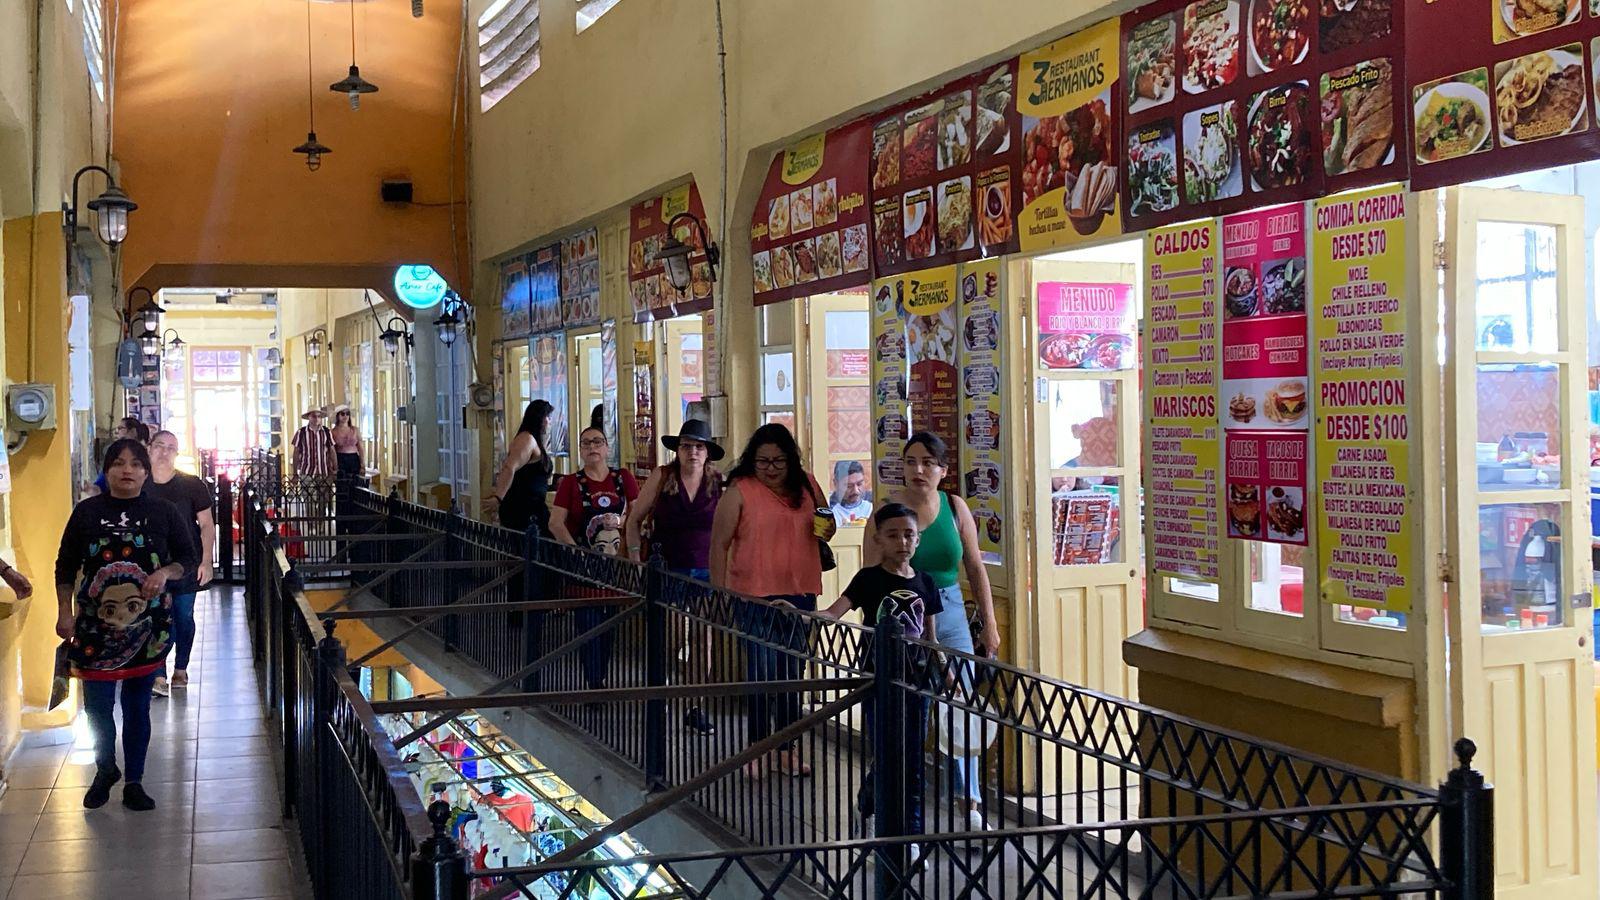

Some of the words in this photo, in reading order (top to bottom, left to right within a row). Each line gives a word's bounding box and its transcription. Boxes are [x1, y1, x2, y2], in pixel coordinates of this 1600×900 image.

[1050, 48, 1100, 78] RESTAURANT
[1028, 60, 1050, 106] 3
[1040, 62, 1104, 102] HERMANOS
[1330, 74, 1360, 90] Pescado
[1360, 68, 1378, 82] Frito
[1269, 96, 1286, 108] Birria
[1201, 112, 1219, 126] Sopes
[1317, 202, 1354, 231] COMIDA
[1358, 193, 1405, 224] CORRIDA
[1226, 220, 1260, 244] MENUDO
[1267, 212, 1299, 236] BIRRIA
[1154, 228, 1210, 256] CALDOS
[1332, 232, 1364, 260] DESDE
[1368, 229, 1386, 255] $70
[1152, 265, 1162, 280] RES
[1202, 258, 1214, 273] $80
[1348, 266, 1368, 280] MOLE
[1152, 284, 1168, 300] POLLO
[1203, 279, 1214, 296] $70
[1332, 286, 1352, 300] CHILE
[1354, 282, 1386, 298] RELLENO
[1060, 287, 1115, 312] MENUDO
[1322, 303, 1354, 318] COSTILLA
[1357, 302, 1366, 315] DE
[1368, 299, 1398, 314] PUERCO
[1152, 306, 1177, 322] PESCADO
[1202, 302, 1214, 318] $80
[1074, 316, 1102, 329] BLANCO
[1337, 318, 1382, 334] ALBONDIGAS
[1152, 326, 1179, 343] CAMARON
[1200, 323, 1214, 340] $100
[1264, 336, 1304, 350] HAMBURGUESA
[1320, 339, 1340, 352] POLLO
[1342, 338, 1351, 351] EN
[1354, 336, 1377, 350] SALSA
[1379, 334, 1404, 348] VERDE
[1152, 348, 1169, 364] MIXTO
[1200, 345, 1214, 362] $120
[1322, 356, 1346, 370] (Incluye
[1348, 355, 1366, 368] Arroz
[1368, 356, 1371, 370] y
[1374, 352, 1404, 367] Frijoles)
[1152, 370, 1179, 388] (Camaron
[1180, 373, 1184, 388] y
[1185, 367, 1214, 388] Pescado)
[1322, 380, 1405, 407] PROMOCION
[1154, 396, 1215, 418] MARISCOS
[1327, 415, 1370, 440] DESDE
[1374, 414, 1408, 441] $100
[1230, 440, 1258, 459] QUESA
[1267, 441, 1291, 459] TACOS
[1338, 448, 1361, 462] CARNE
[1363, 449, 1387, 462] ASADA
[1229, 460, 1259, 478] BIRRIA
[1270, 462, 1298, 480] BIRRIA
[1331, 465, 1366, 479] MILANESA
[1368, 466, 1377, 480] DE
[1380, 467, 1395, 480] RES
[1323, 482, 1347, 495] BISTEC
[1349, 483, 1353, 495] A
[1355, 483, 1363, 496] LA
[1366, 483, 1405, 498] MEXICANA
[1325, 499, 1348, 512] BISTEC
[1350, 500, 1404, 515] ENCEBOLLADO
[1328, 516, 1363, 531] MILANESA
[1364, 518, 1374, 531] DE
[1376, 519, 1400, 533] POLLO
[1341, 534, 1364, 548] POLLO
[1366, 535, 1386, 549] FRITO
[1333, 549, 1359, 564] FAJITAS
[1361, 551, 1371, 565] DE
[1373, 553, 1397, 568] POLLO
[1378, 571, 1405, 588] Frijoles
[1345, 584, 1350, 597] Y
[1352, 585, 1386, 603] Ensalada)
